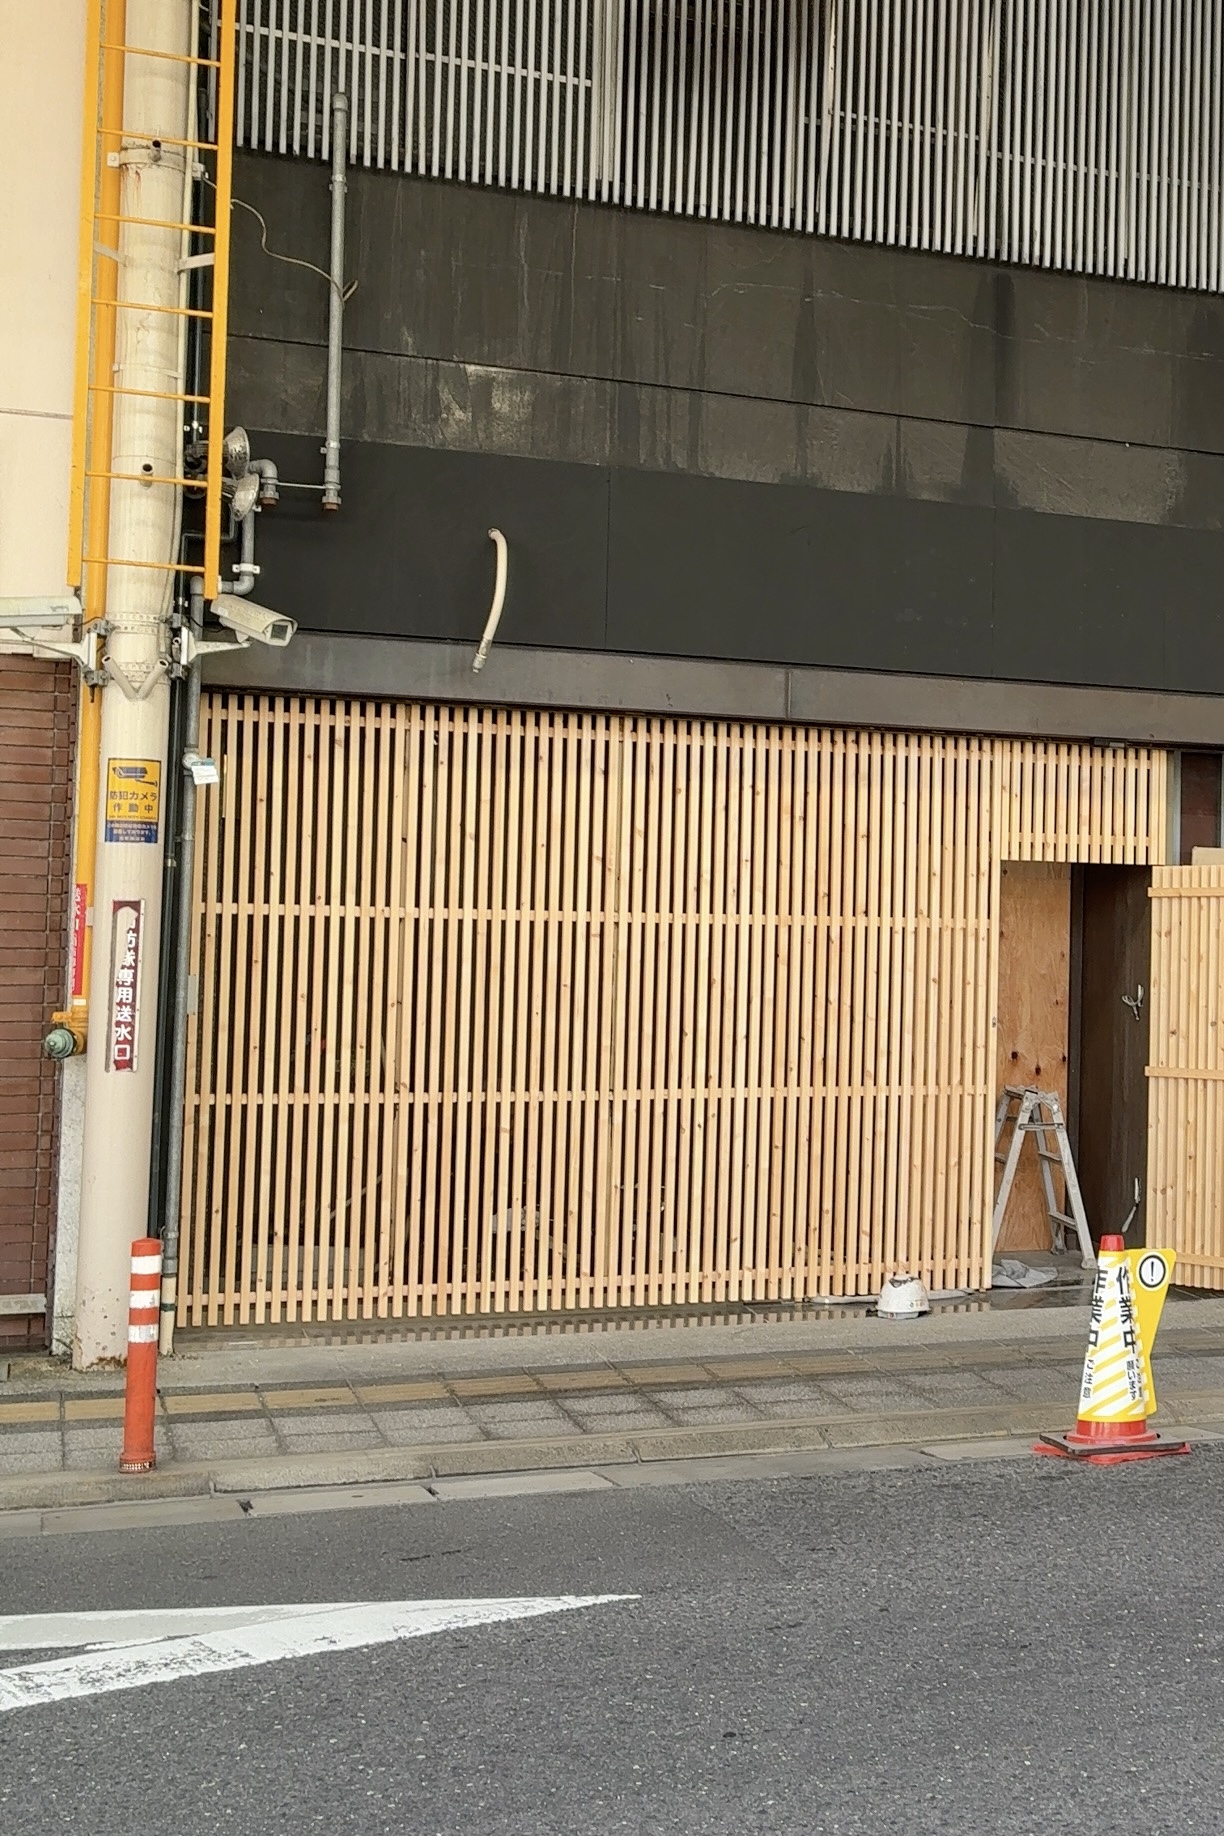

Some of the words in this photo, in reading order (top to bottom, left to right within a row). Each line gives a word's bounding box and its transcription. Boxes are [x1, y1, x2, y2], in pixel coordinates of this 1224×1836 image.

[109, 790, 158, 802] 防犯カメラ
